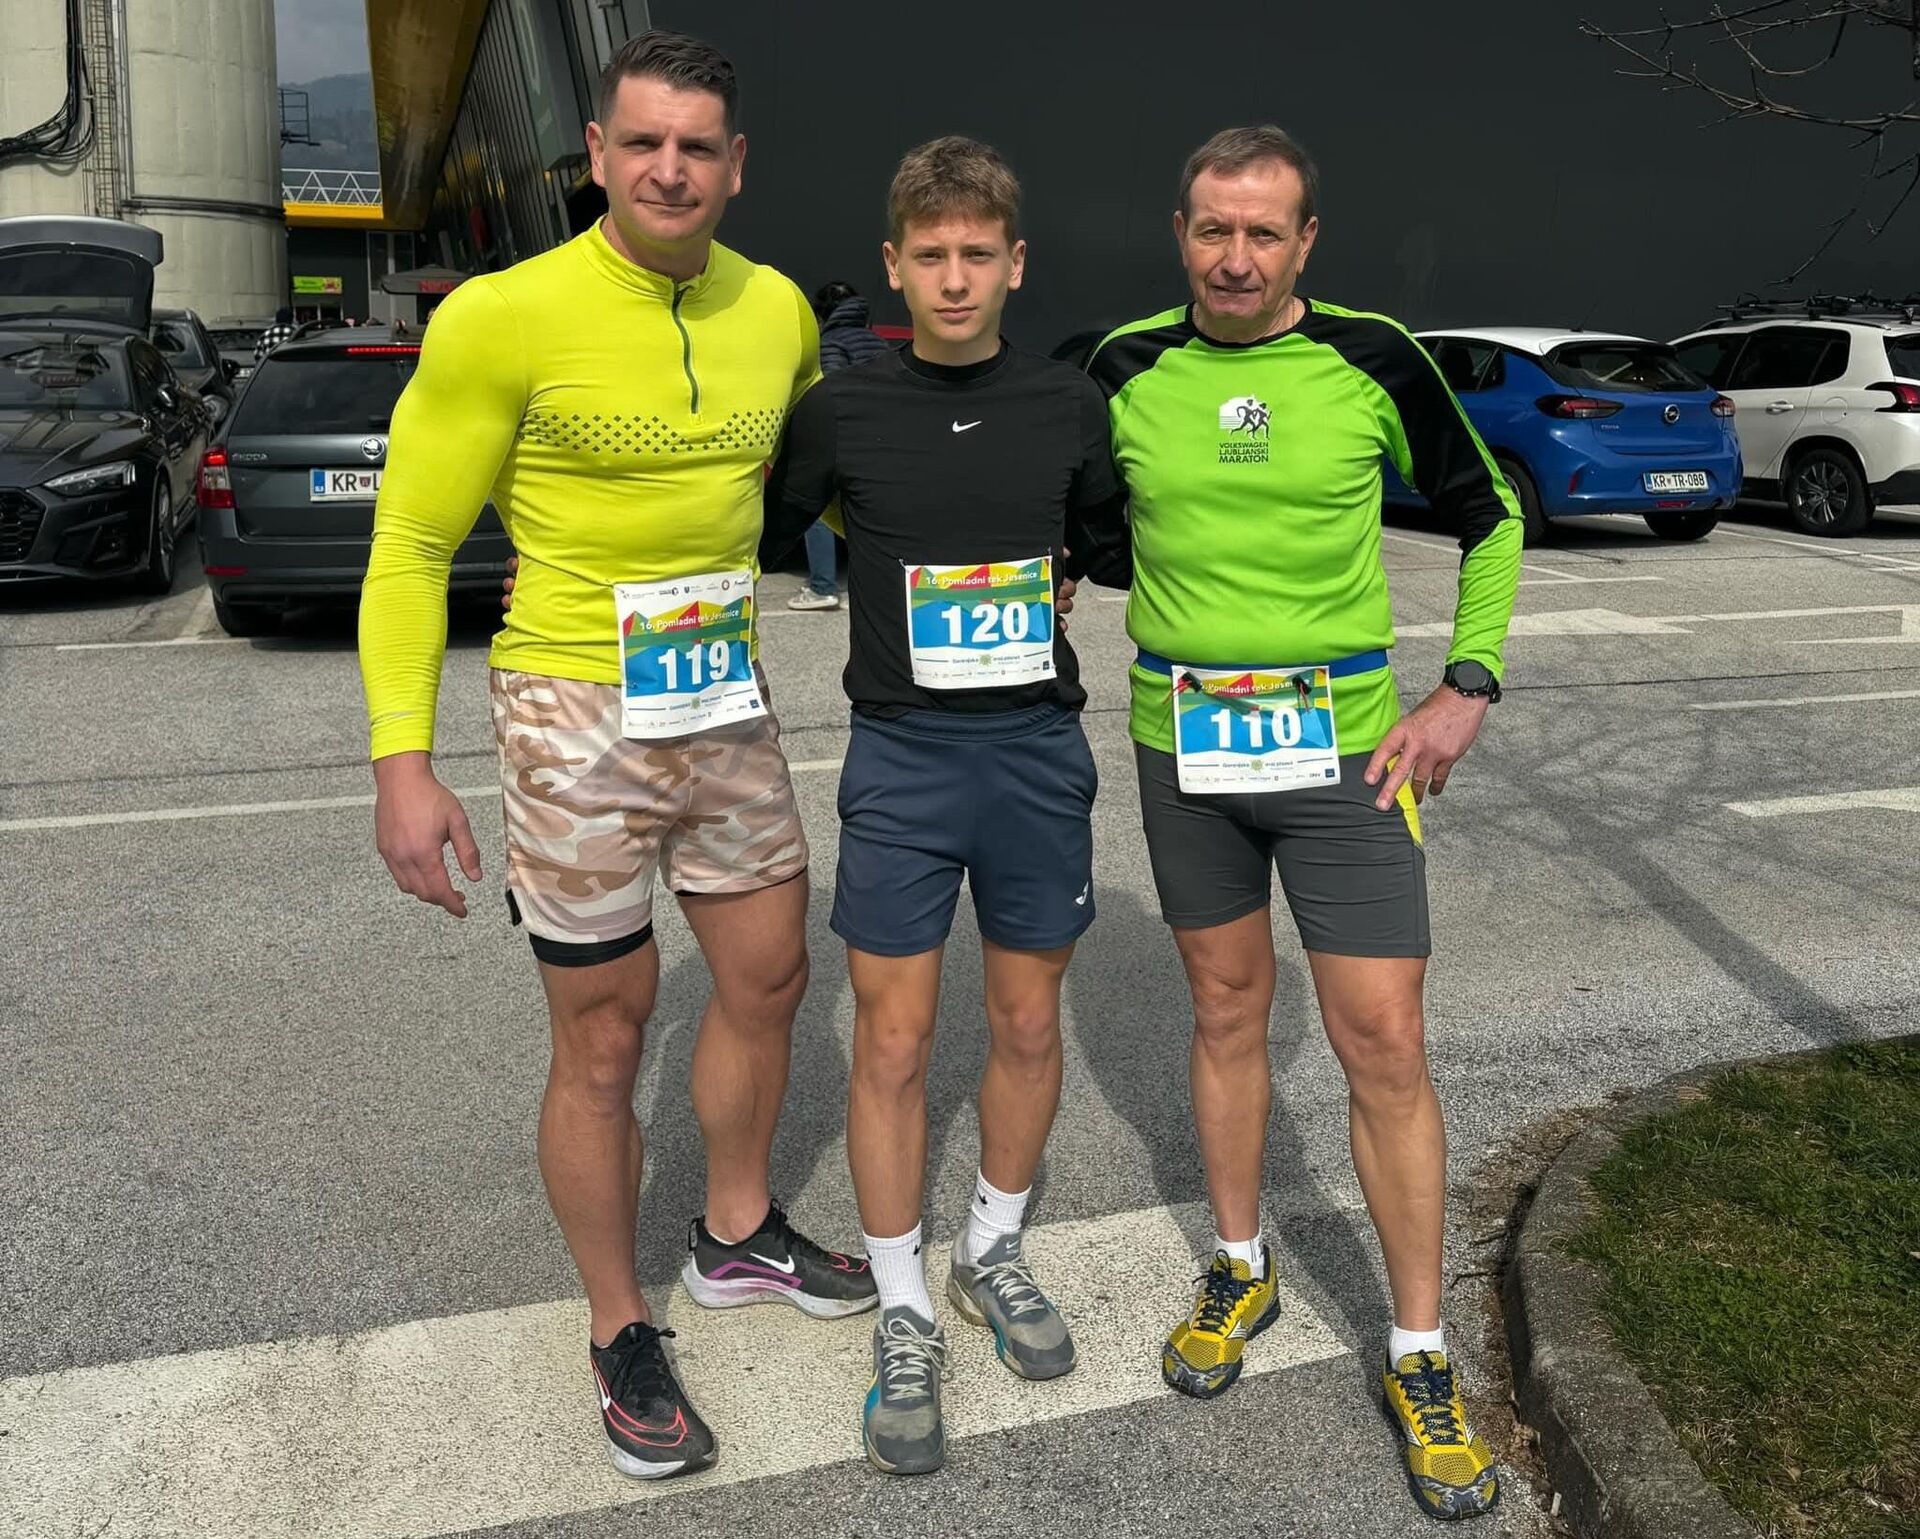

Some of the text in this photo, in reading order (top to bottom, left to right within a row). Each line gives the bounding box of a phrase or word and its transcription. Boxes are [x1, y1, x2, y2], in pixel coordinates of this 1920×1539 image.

[1219, 455, 1269, 463] MARATON
[332, 473, 357, 492] KR
[1652, 474, 1667, 487] KR
[927, 577, 940, 585] 16.
[943, 575, 986, 585] Pomladni
[640, 621, 655, 631] 16.
[657, 614, 697, 629] Pomladni
[941, 601, 1029, 644] 120
[658, 640, 730, 690] 119
[1208, 684, 1250, 694] Pomladni
[1210, 707, 1301, 748] 110
